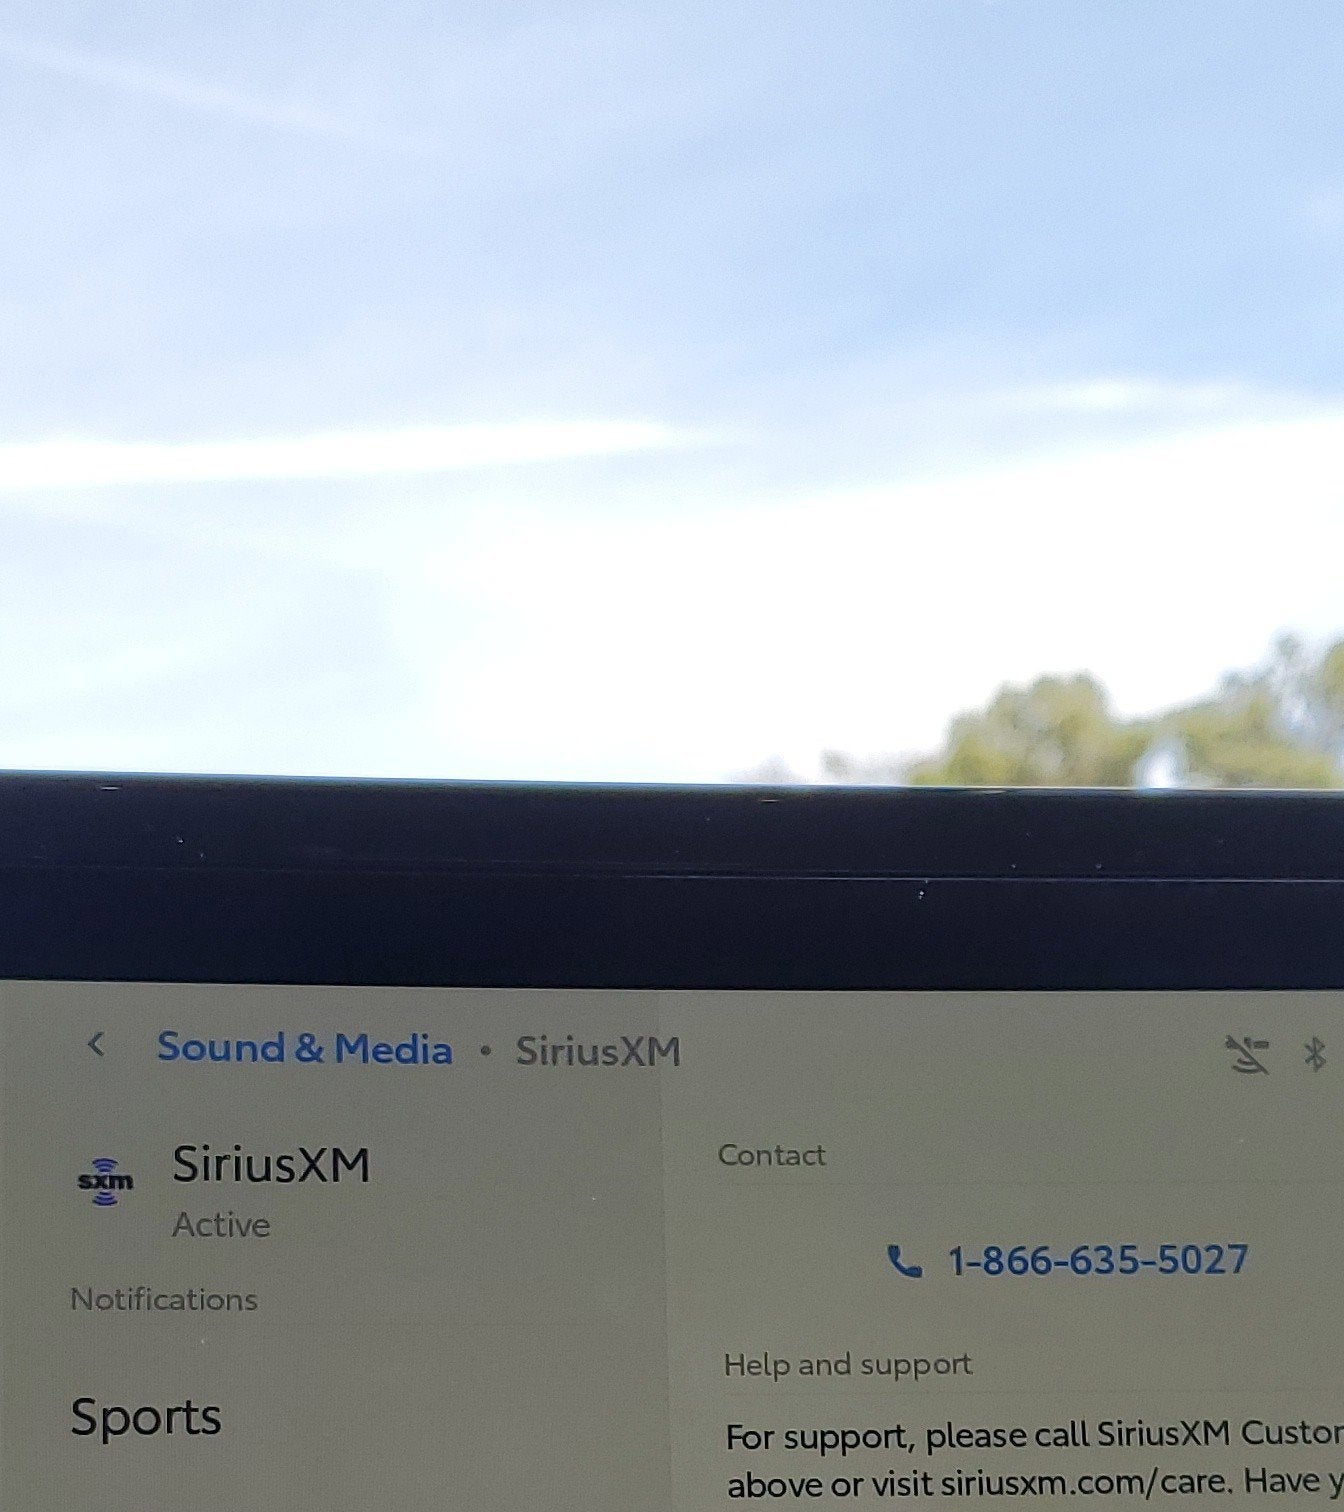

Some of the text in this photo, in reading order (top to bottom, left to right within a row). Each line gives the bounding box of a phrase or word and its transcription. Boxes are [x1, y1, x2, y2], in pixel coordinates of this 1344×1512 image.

[158, 1031, 679, 1066] Sound & Media SiriusXM
[174, 1144, 368, 1182] SiriusXM
[718, 1144, 826, 1166] Contact
[77, 1174, 134, 1190] sxm
[172, 1211, 270, 1237] Active
[950, 1244, 1248, 1275] 1-866-635-5027
[71, 1286, 257, 1311] Notifications
[725, 1351, 973, 1382] Help and support
[72, 1398, 221, 1444] Sports
[728, 1425, 775, 1449] For
[785, 1425, 914, 1456] support,
[927, 1422, 1027, 1455] please
[1035, 1420, 1090, 1447] call
[1099, 1420, 1229, 1446] SiriusXM
[729, 1472, 822, 1498] above
[831, 1478, 864, 1496] or
[872, 1470, 934, 1496] visit
[942, 1467, 1232, 1500] siriusxm.com/care.
[1245, 1468, 1320, 1493] Have
